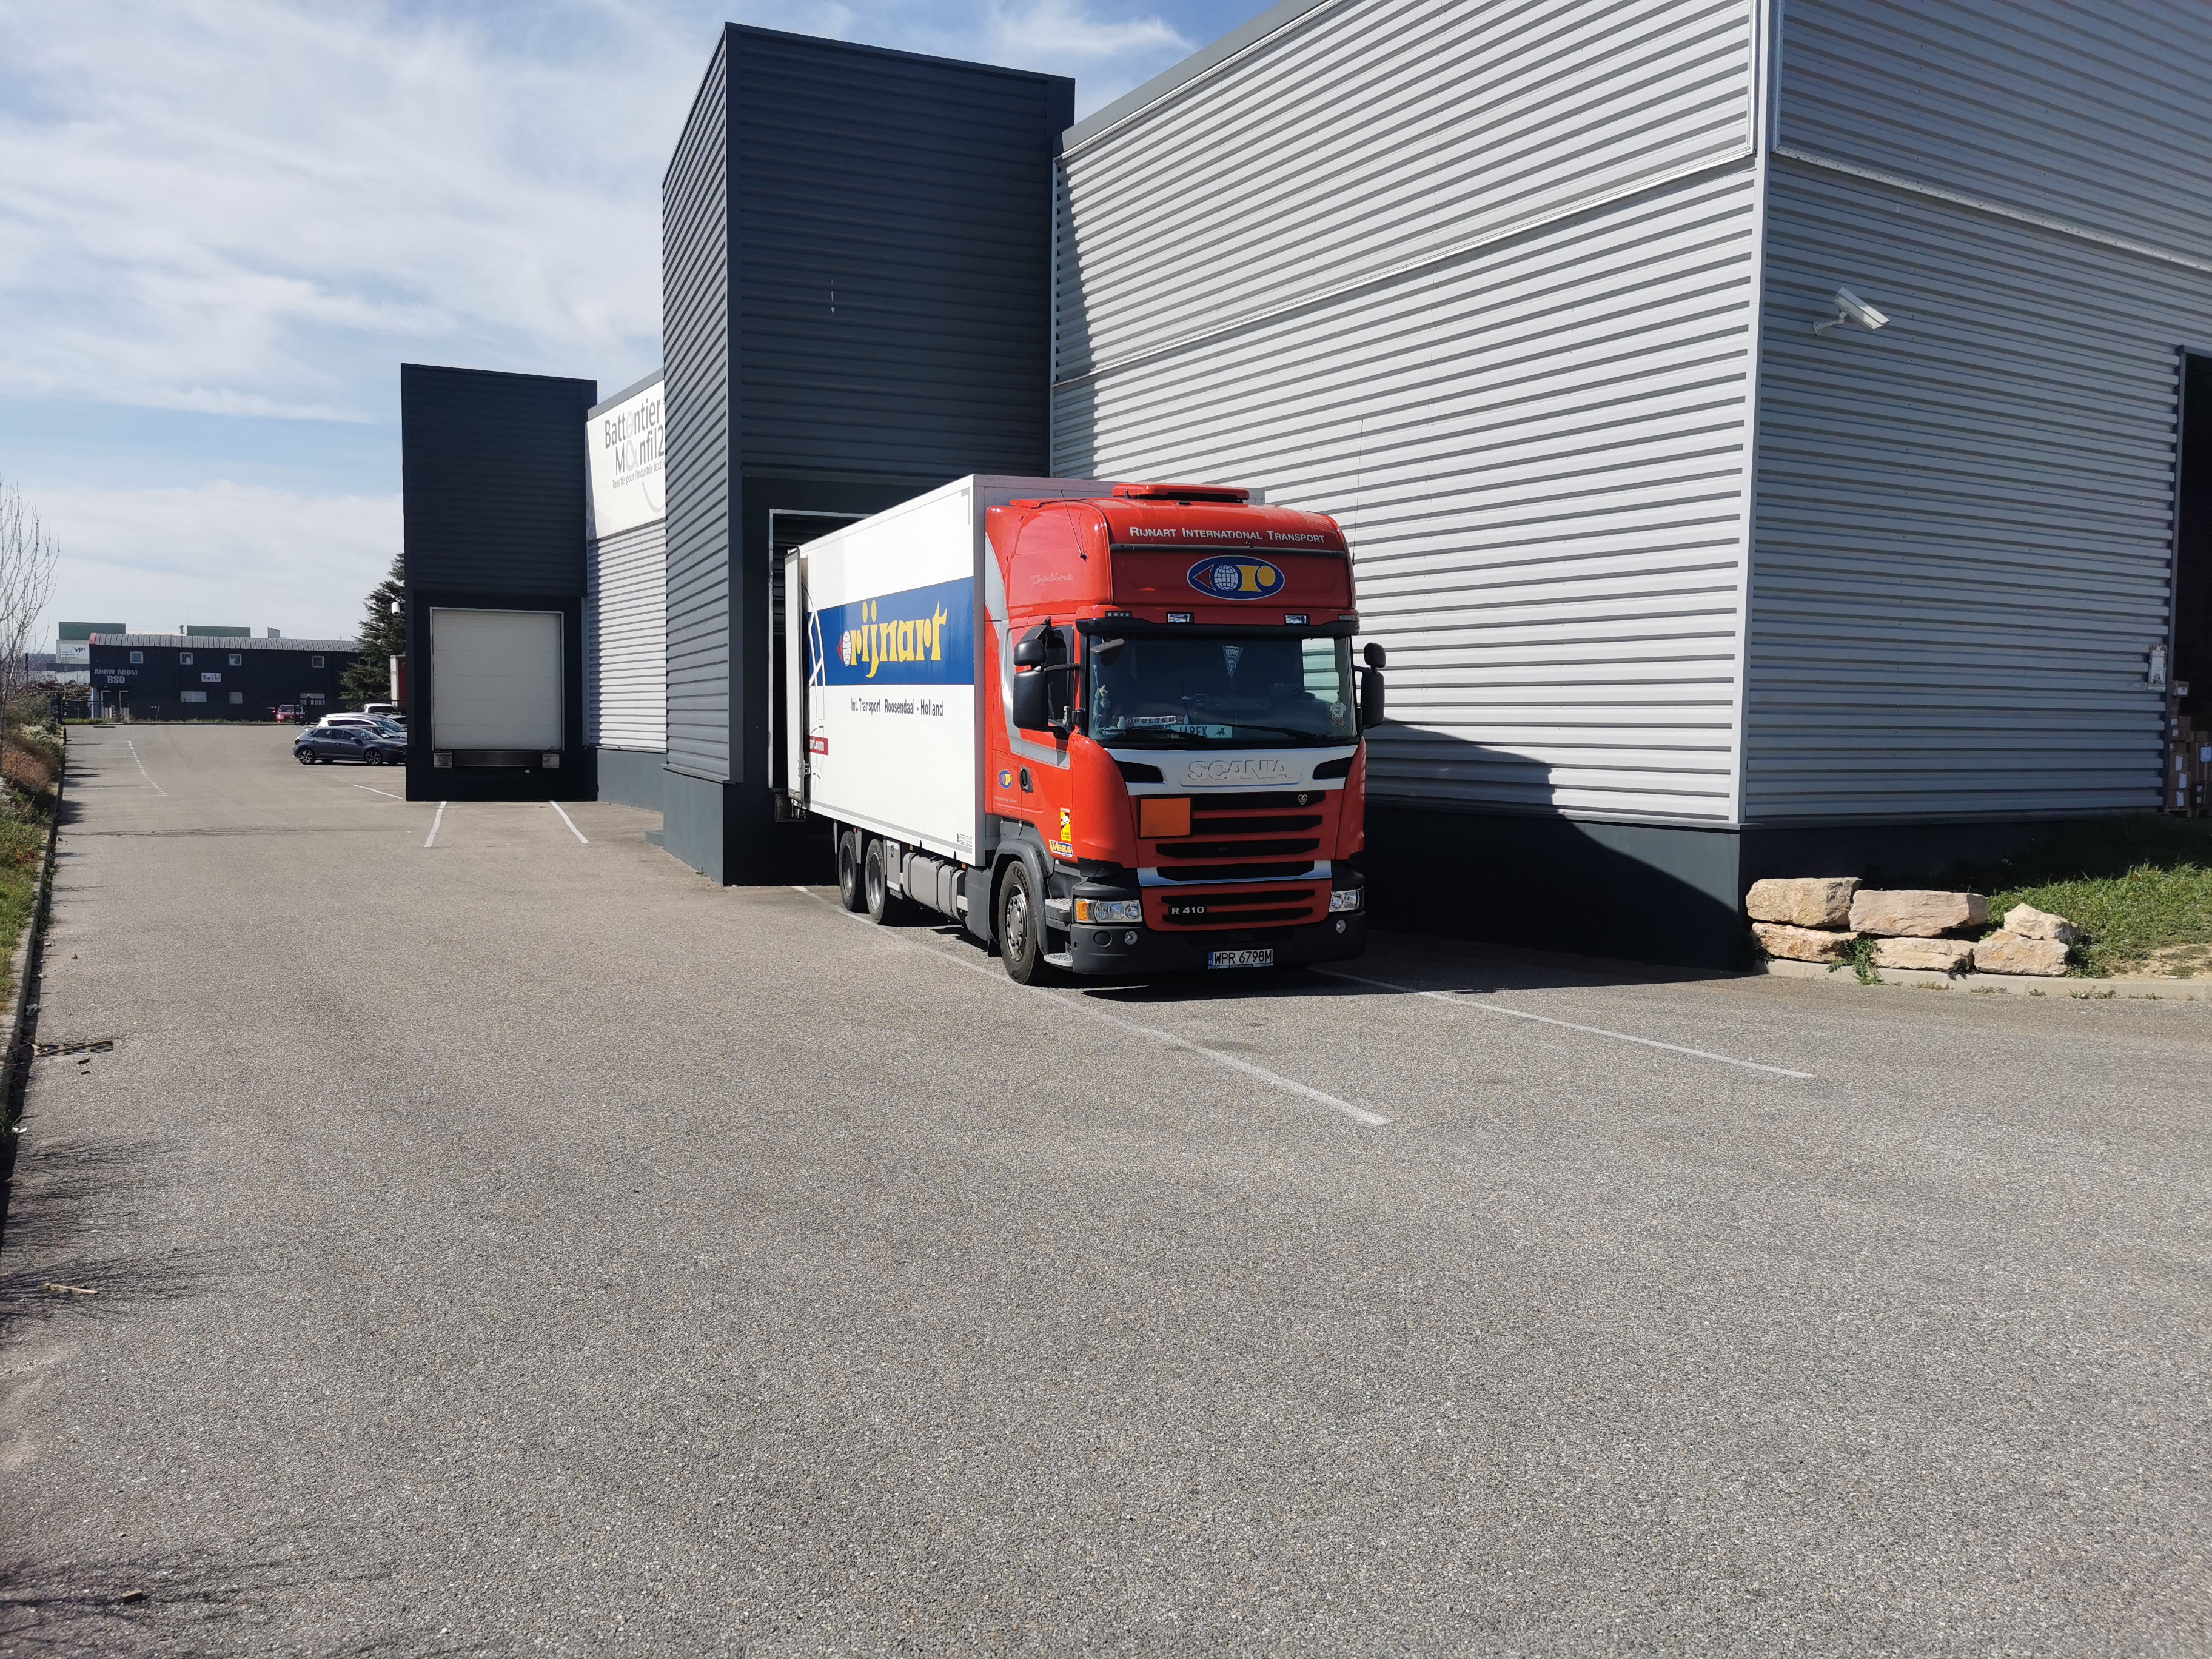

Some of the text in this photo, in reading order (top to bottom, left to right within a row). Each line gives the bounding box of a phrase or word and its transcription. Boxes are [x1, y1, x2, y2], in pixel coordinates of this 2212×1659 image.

[605, 398, 661, 449] Battentier
[626, 473, 634, 486] pour
[107, 675, 126, 684] BSO
[859, 697, 881, 716] Transport
[885, 698, 915, 715] Roosendaal
[920, 699, 943, 716] Holland
[1187, 759, 1293, 781] SCANIA
[1051, 840, 1073, 854] VEBA
[1215, 950, 1272, 965] WPR 6798M
